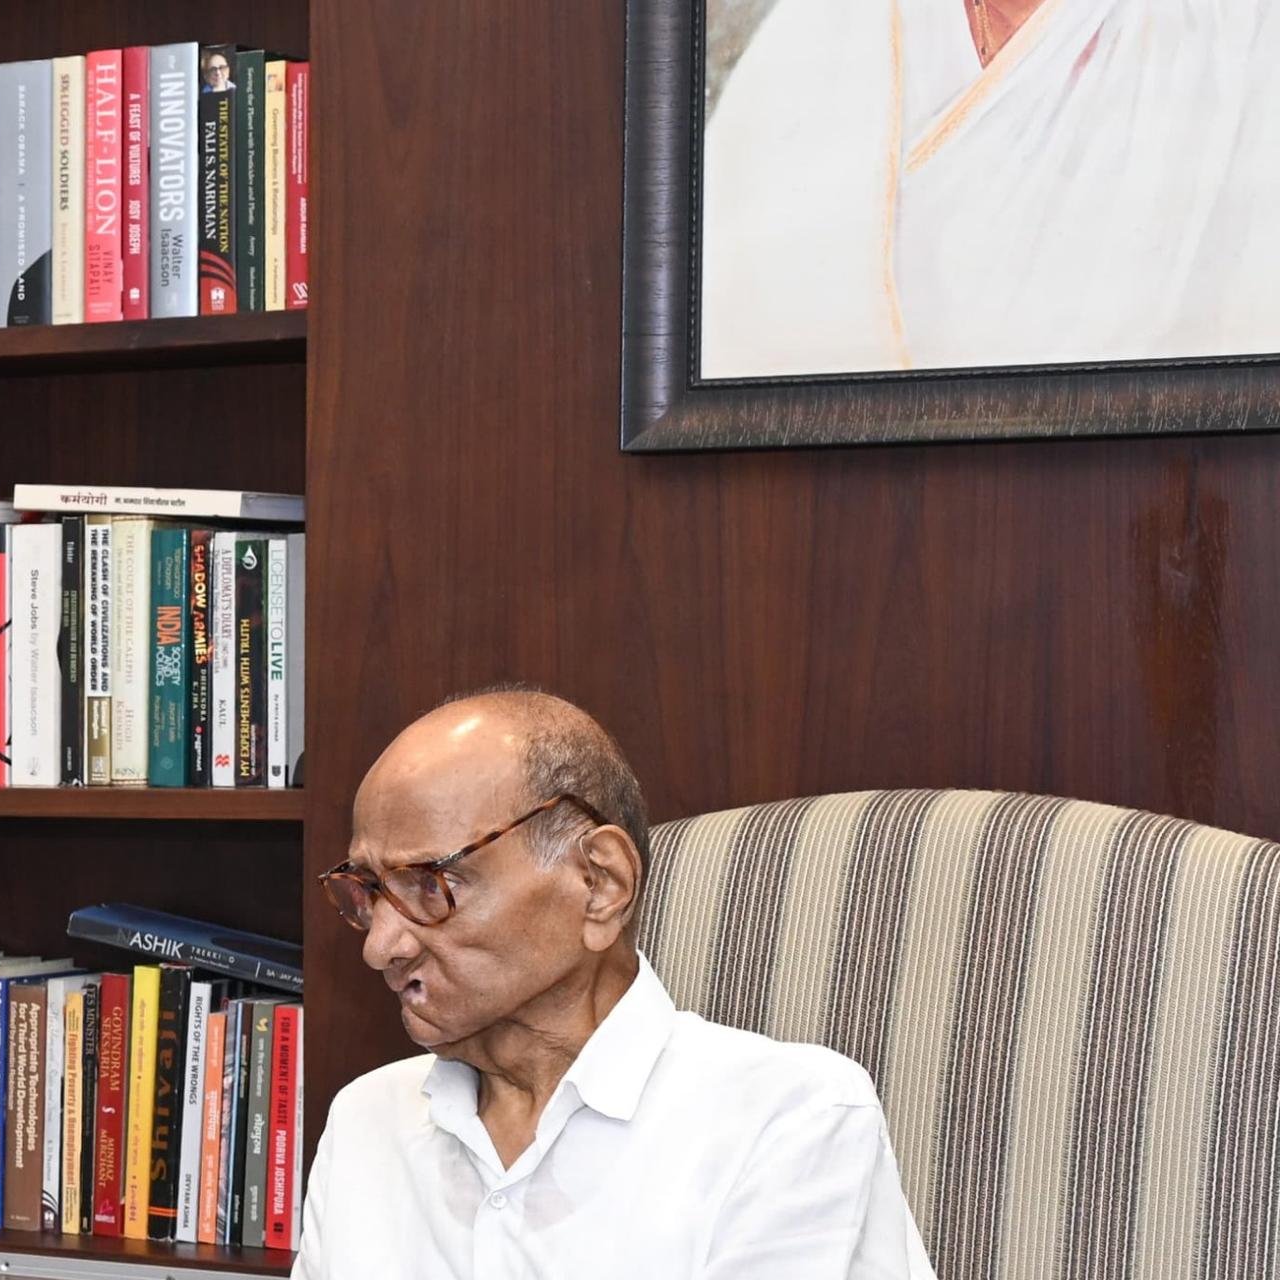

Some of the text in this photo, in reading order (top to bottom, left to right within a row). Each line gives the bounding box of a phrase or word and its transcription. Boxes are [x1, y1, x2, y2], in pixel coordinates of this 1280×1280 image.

[130, 104, 141, 128] FEAST
[130, 131, 141, 142] OF
[96, 63, 117, 237] HALF-LION
[130, 145, 141, 185] VULTURES
[159, 72, 185, 222] INNOVATORS
[18, 194, 25, 202] A
[60, 150, 70, 211] SOLDIERS
[205, 121, 216, 239] FALI S. NARIMAN
[219, 98, 228, 253] THE STATE OF THE NATION
[130, 199, 141, 255] JOSY JOSEPH
[89, 245, 101, 296] SITAPATI
[103, 251, 113, 283] VINAY
[160, 228, 172, 287] Isaacson
[171, 235, 183, 278] Walter
[59, 494, 107, 506] कर्मयोगी
[90, 529, 98, 691] THE REMAKING OF WORLD ORDER
[101, 528, 109, 691] THE CLASH OF CIVILIZATIONS AND
[125, 535, 135, 685] THE COURT OF THE CALIPHS
[192, 545, 209, 664] SHADOW ARMIES
[221, 557, 232, 611] DIPLOMAT'S
[156, 606, 182, 645] INDIA
[221, 613, 232, 640] DIARY
[270, 549, 283, 681] LICENSE TO LIVE
[28, 569, 40, 736] Steve Jobs by Walter Isaacson
[155, 646, 165, 686] POLITICS
[164, 655, 173, 677] AND
[172, 646, 181, 686] SOCIETY
[192, 681, 199, 690] K.
[240, 619, 251, 777] MY EXPERIMENTS WITH TRUTH
[218, 699, 227, 728] KAUL
[86, 987, 96, 1006] YES
[85, 1008, 95, 1056] MINISTER
[100, 1016, 111, 1078] SEKSARIA
[109, 1006, 123, 1090] GOVINDRAM
[189, 996, 203, 1105] RIGHTS OF THE WRONGS
[280, 1016, 290, 1033] FOR
[7, 1001, 17, 1110] Edited by Austin Robinson
[27, 1002, 40, 1151] Appropriate Technologies
[67, 1033, 78, 1070] Fighting
[279, 1044, 289, 1083] MOMENT
[14, 1002, 28, 1168] for Third World Development
[67, 1072, 78, 1108] Poverty
[150, 1010, 177, 1181] Shivaji
[278, 1085, 287, 1096] OF
[277, 1098, 287, 1125] TASTE
[66, 1117, 77, 1185] Unemployment
[98, 1129, 108, 1187] MERCHANT
[106, 1138, 115, 1181] MINHAZ
[274, 1129, 286, 1215] POORVA JOSHIPURA
[184, 1173, 192, 1204] DEVYANI
